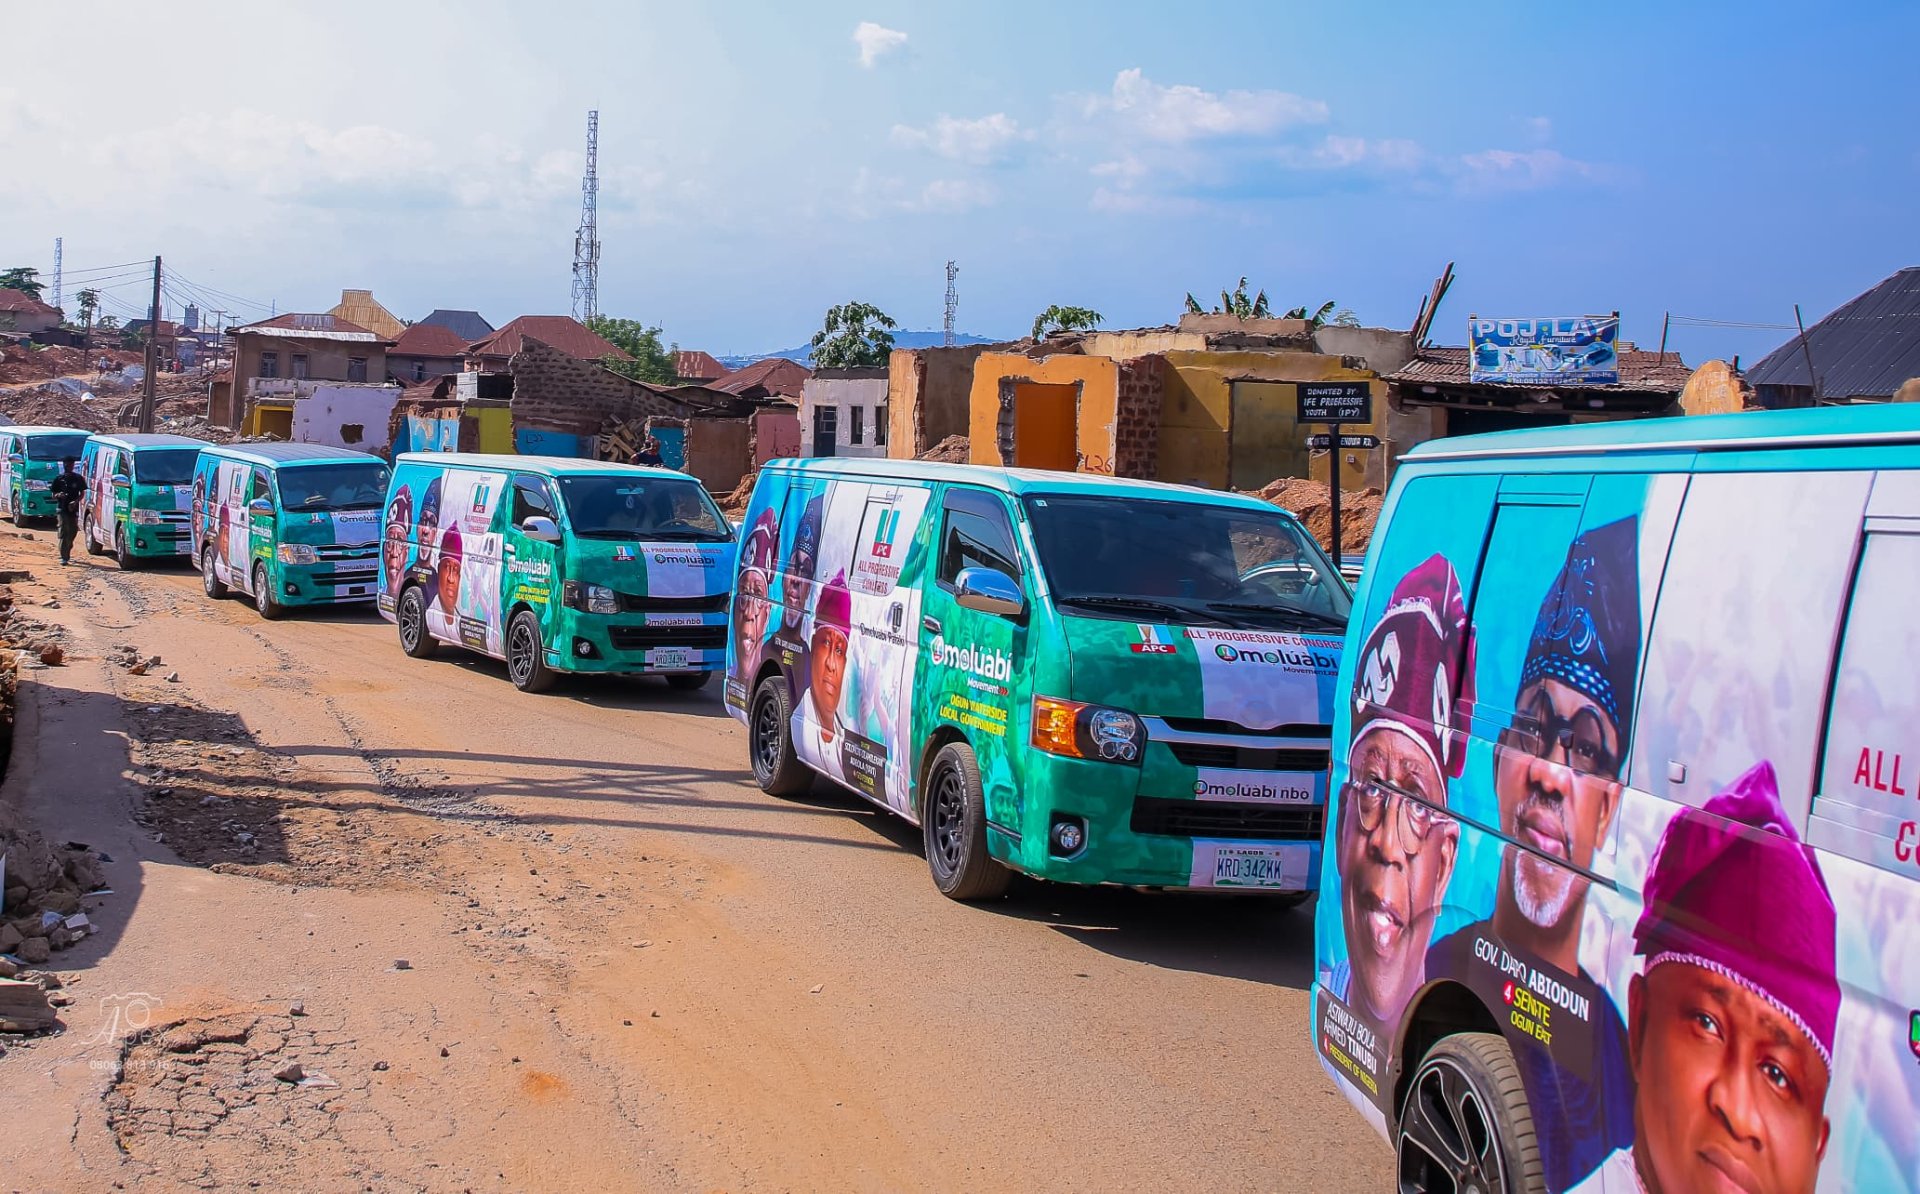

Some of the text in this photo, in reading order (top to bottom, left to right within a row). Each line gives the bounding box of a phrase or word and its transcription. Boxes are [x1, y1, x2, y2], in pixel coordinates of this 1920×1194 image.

[1303, 397, 1364, 407] IFE PROGRESSIVE
[1305, 407, 1360, 417] YOUTH (IPY)
[1084, 454, 1112, 473] L26
[858, 559, 868, 573] ALL
[1183, 629, 1206, 640] ALL
[1207, 631, 1291, 645] PROGRESSIVE
[1141, 644, 1168, 653] APC
[966, 676, 1000, 695] Movement
[950, 693, 1008, 722] OGUN WATERSIDE
[940, 704, 1007, 737] LOCAL GOVERNMENT
[1853, 746, 1906, 797] ALL
[1475, 937, 1498, 967] GOV.
[1528, 968, 1590, 1022] ABIODUN
[1326, 1000, 1376, 1052] ASIWAJU BOLA
[1510, 1010, 1535, 1036] OGUN
[1323, 1016, 1377, 1076] AHMED TINUBU
